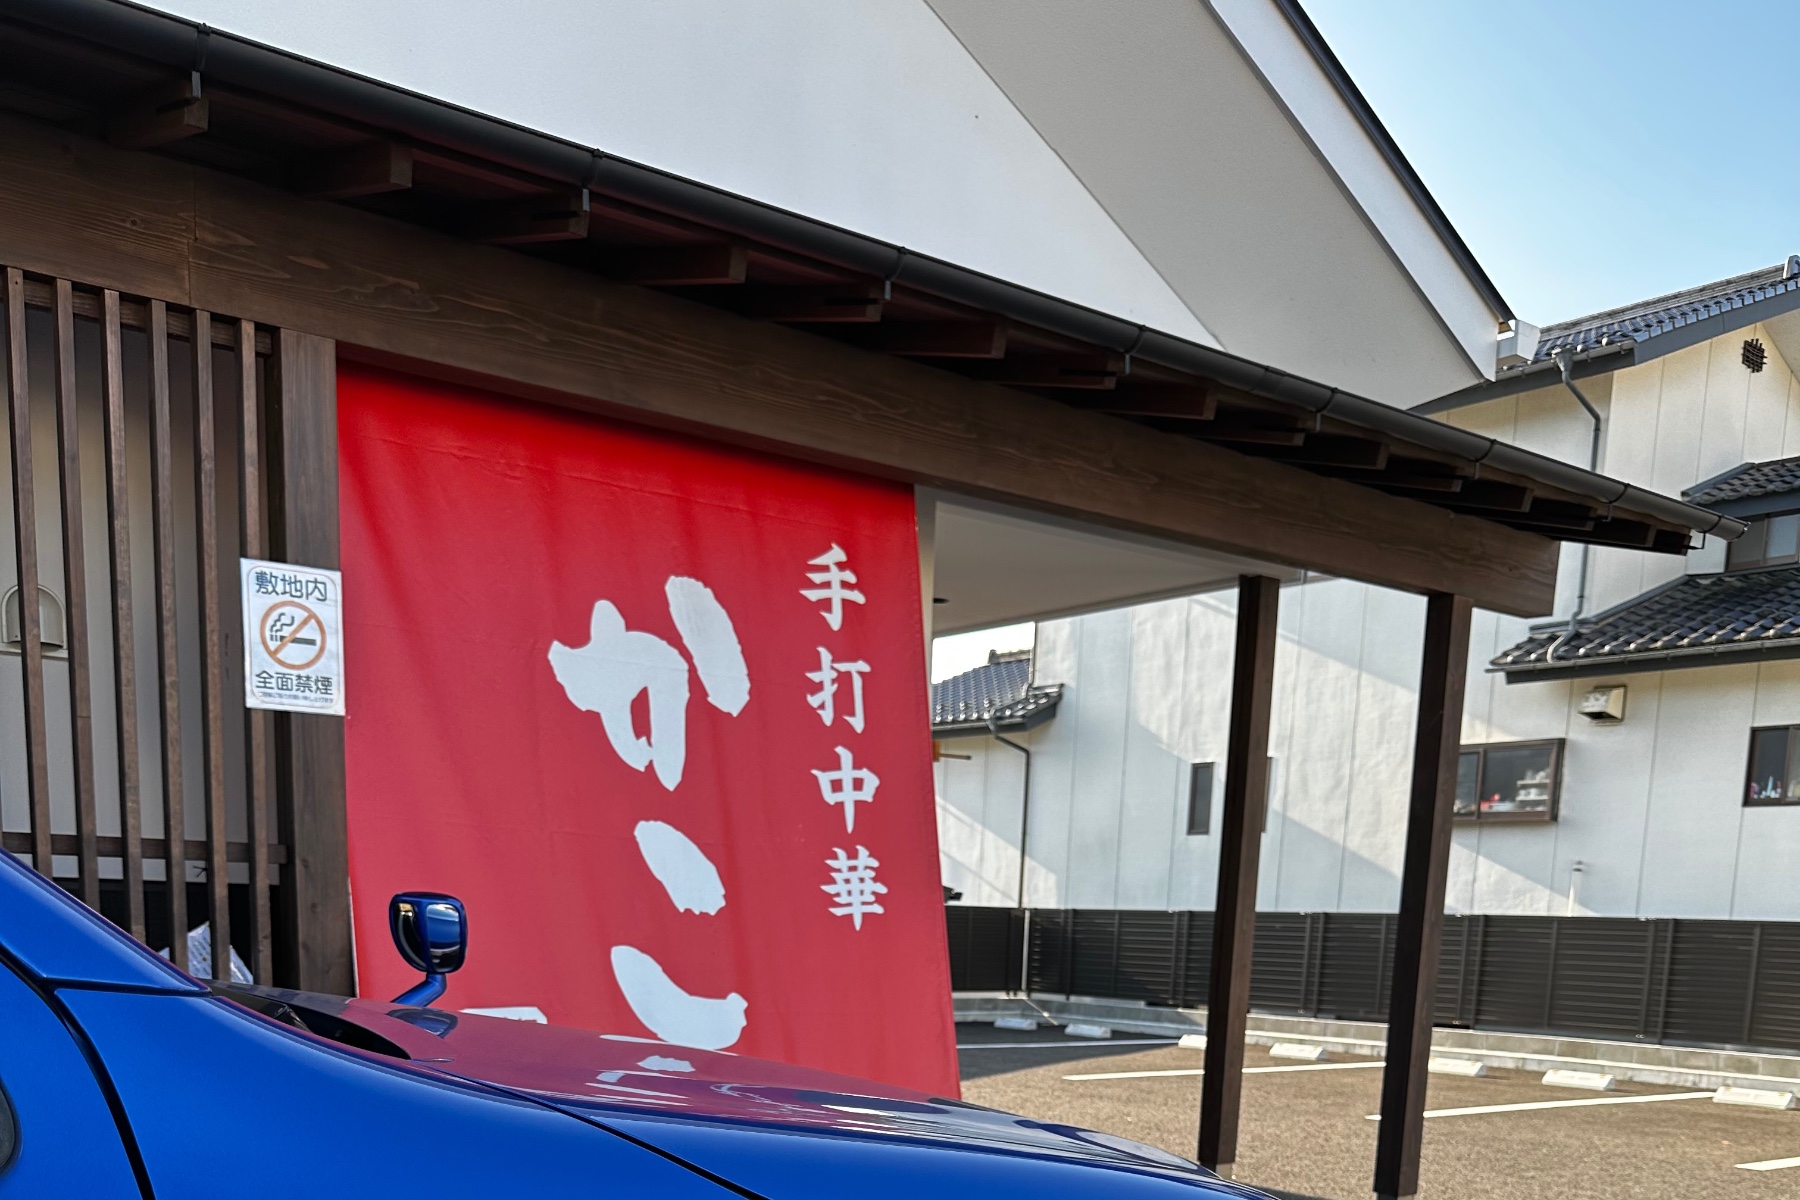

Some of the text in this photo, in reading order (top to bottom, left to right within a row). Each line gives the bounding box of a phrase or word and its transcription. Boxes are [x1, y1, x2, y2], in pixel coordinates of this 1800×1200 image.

[255, 570, 328, 602] 敷地内
[255, 670, 334, 696] 全面禁煙
[799, 543, 888, 931] 手打中華
